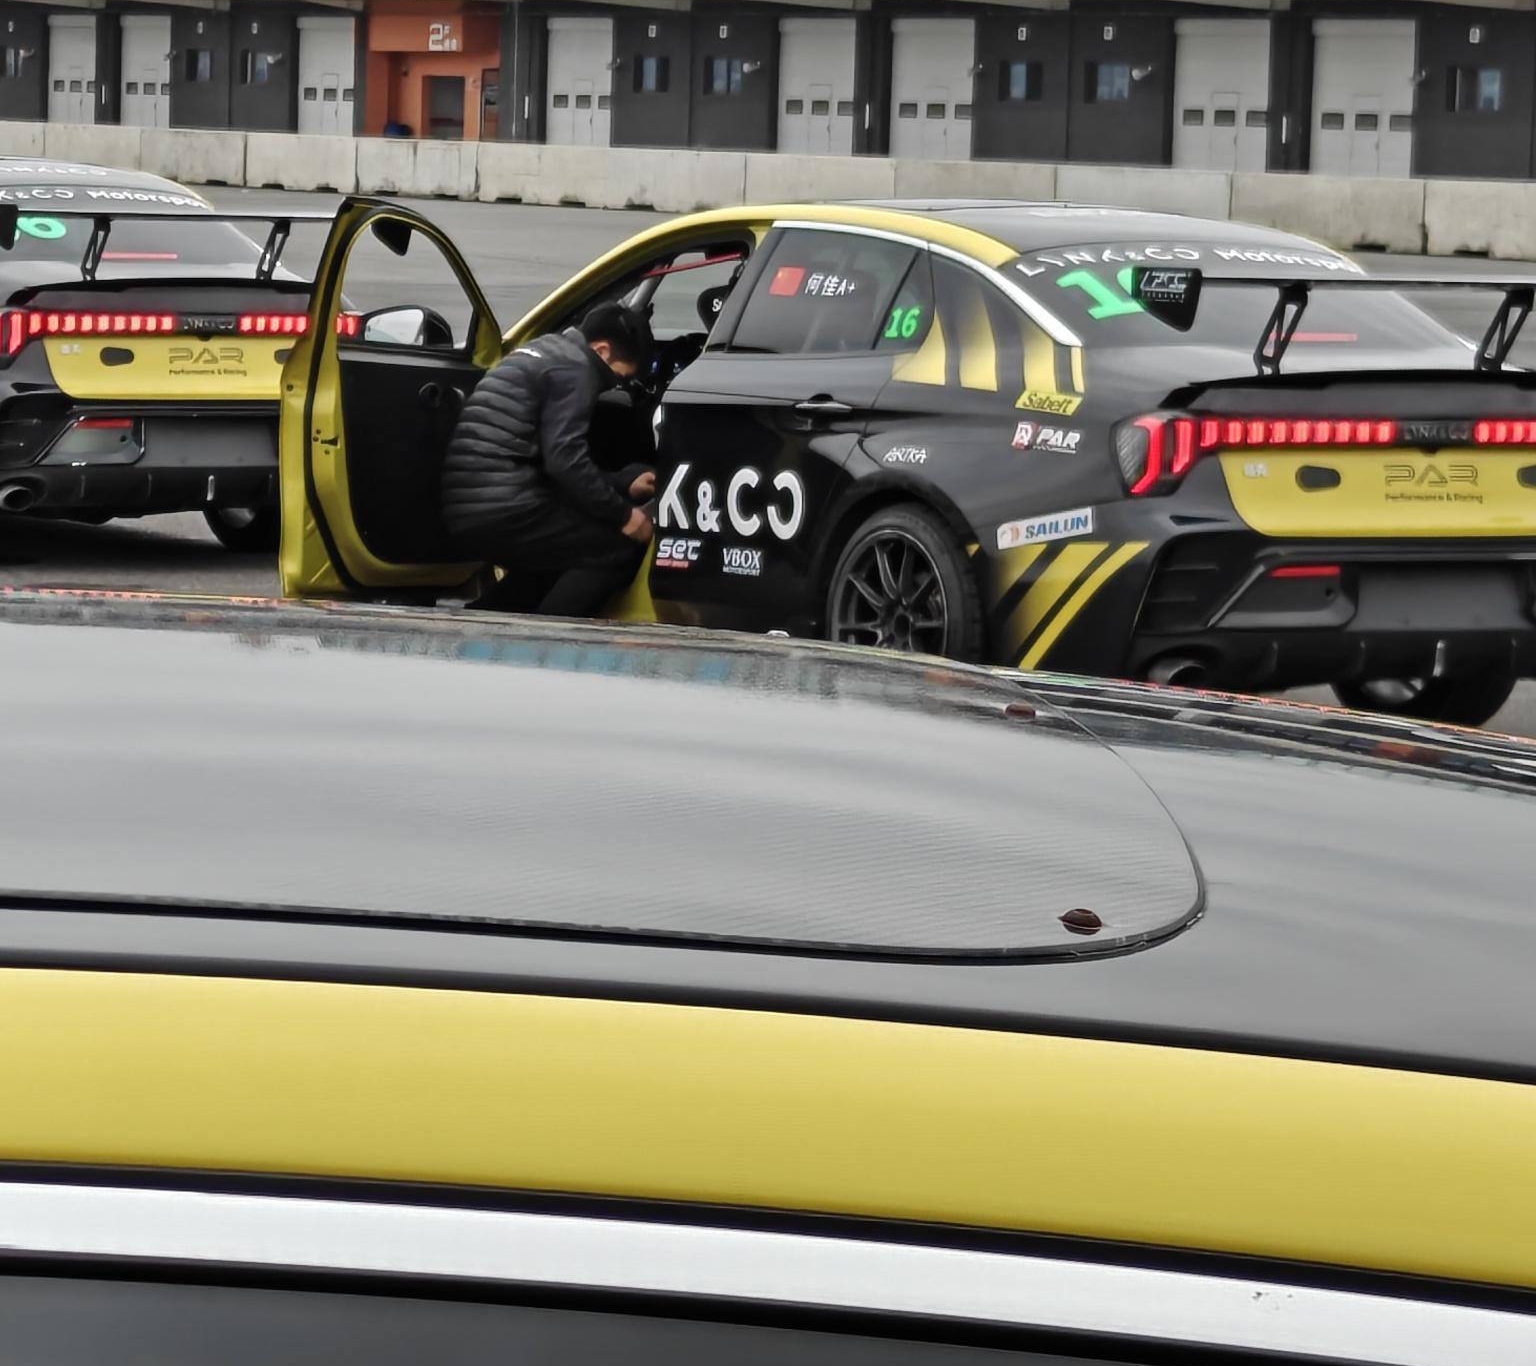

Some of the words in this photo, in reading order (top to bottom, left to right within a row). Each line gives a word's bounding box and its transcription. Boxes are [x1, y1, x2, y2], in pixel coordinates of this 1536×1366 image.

[884, 305, 921, 338] 16
[1024, 514, 1089, 539] SAILUN
[722, 547, 762, 570] VBOX
